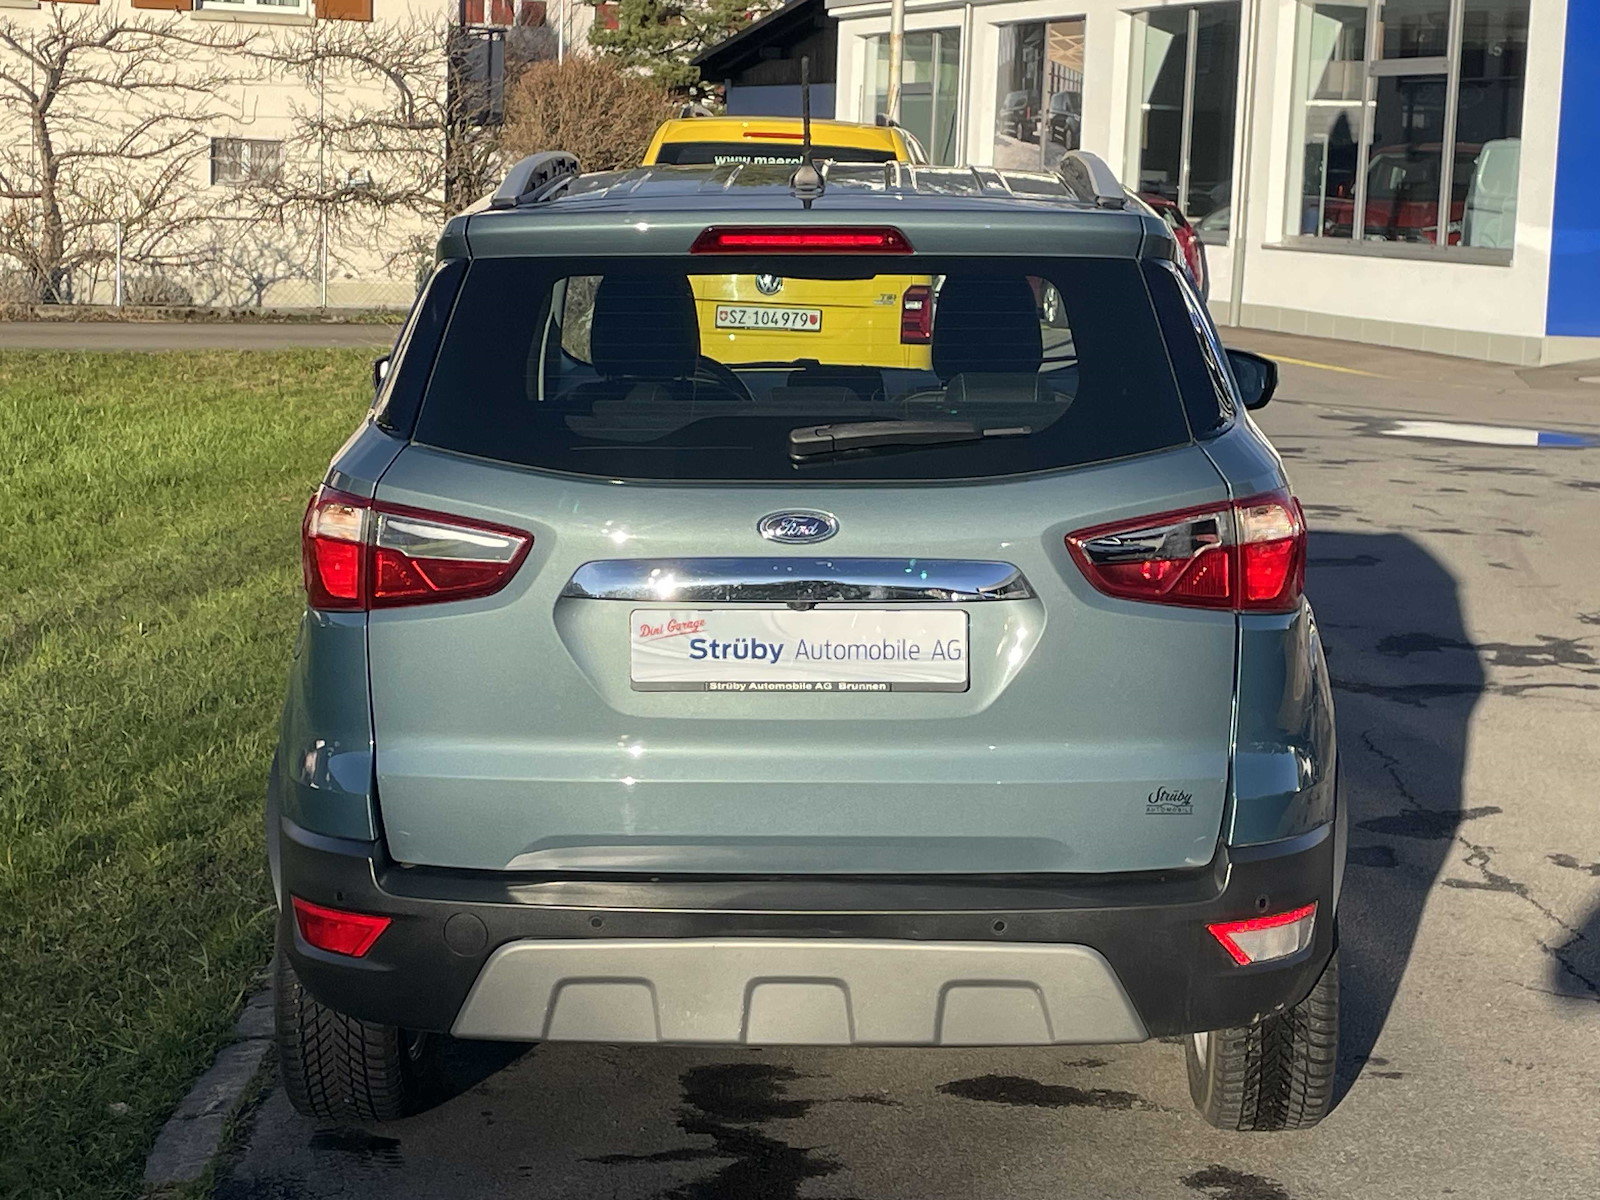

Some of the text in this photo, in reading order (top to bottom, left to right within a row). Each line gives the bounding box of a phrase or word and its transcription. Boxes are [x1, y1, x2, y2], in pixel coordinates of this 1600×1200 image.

[729, 310, 808, 327] SZ 104979
[776, 517, 819, 536] Ford
[639, 618, 706, 638] Dini Garage
[689, 638, 962, 664] Strüby Automobile AG
[709, 682, 887, 691] Strüby Automobile AG Brunnen
